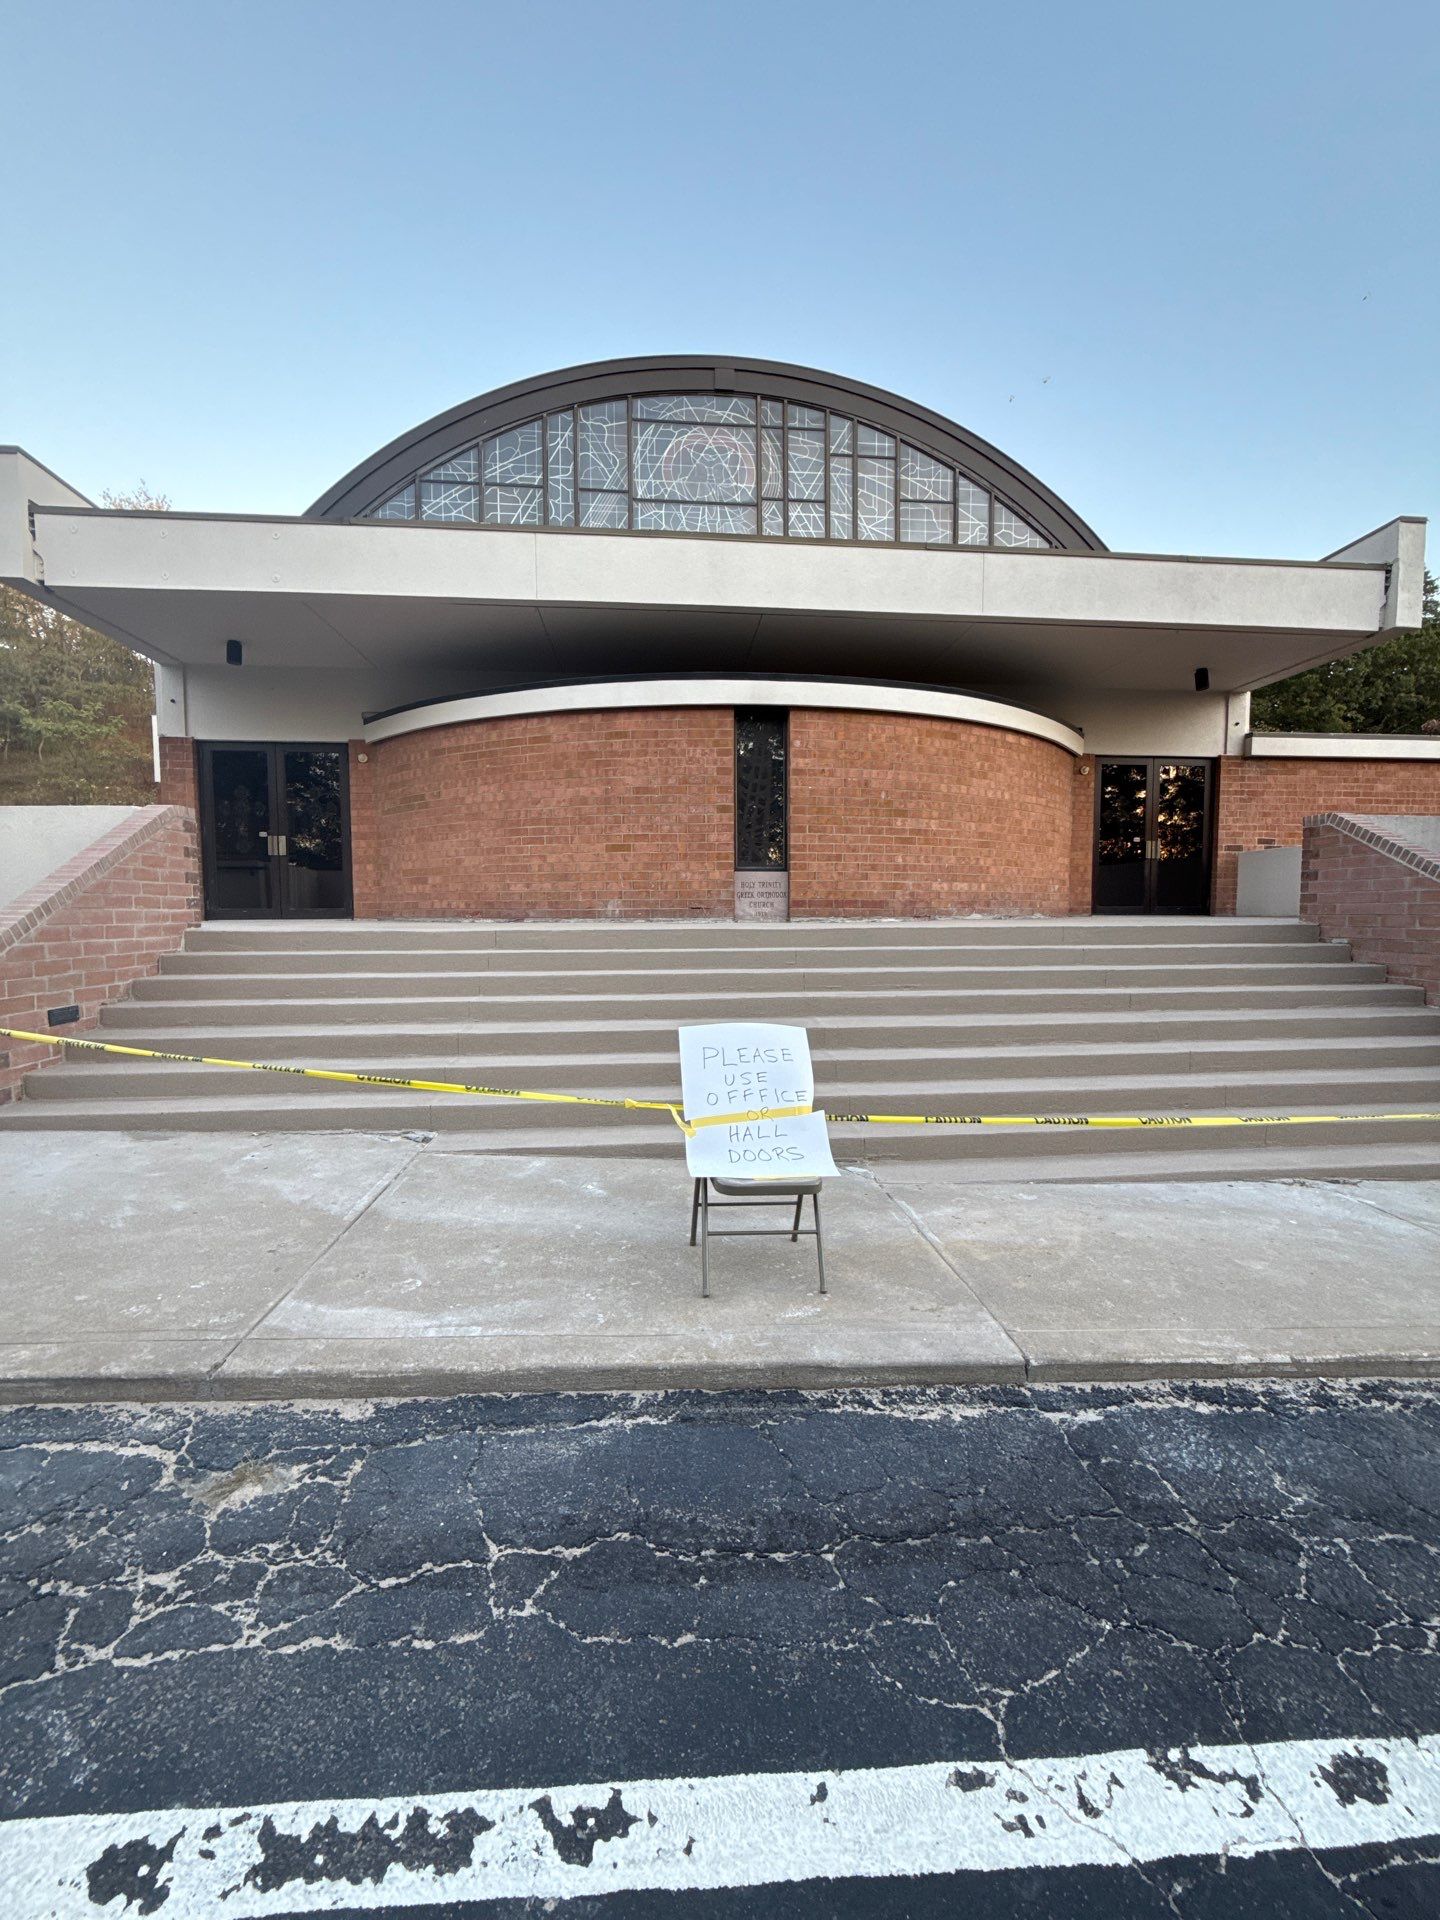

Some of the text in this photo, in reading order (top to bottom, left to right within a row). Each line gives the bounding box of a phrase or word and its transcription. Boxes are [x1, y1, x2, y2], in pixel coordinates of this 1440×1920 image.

[740, 881, 782, 889] HOLY TRINITY
[736, 891, 755, 899] GREEK
[749, 901, 775, 909] CHURCH
[702, 1046, 794, 1069] PLEASE
[724, 1071, 768, 1087] USE
[706, 1088, 808, 1106] OFFICE
[746, 1106, 774, 1121] OR
[728, 1124, 788, 1143] HALL
[728, 1147, 804, 1163] DOORS
